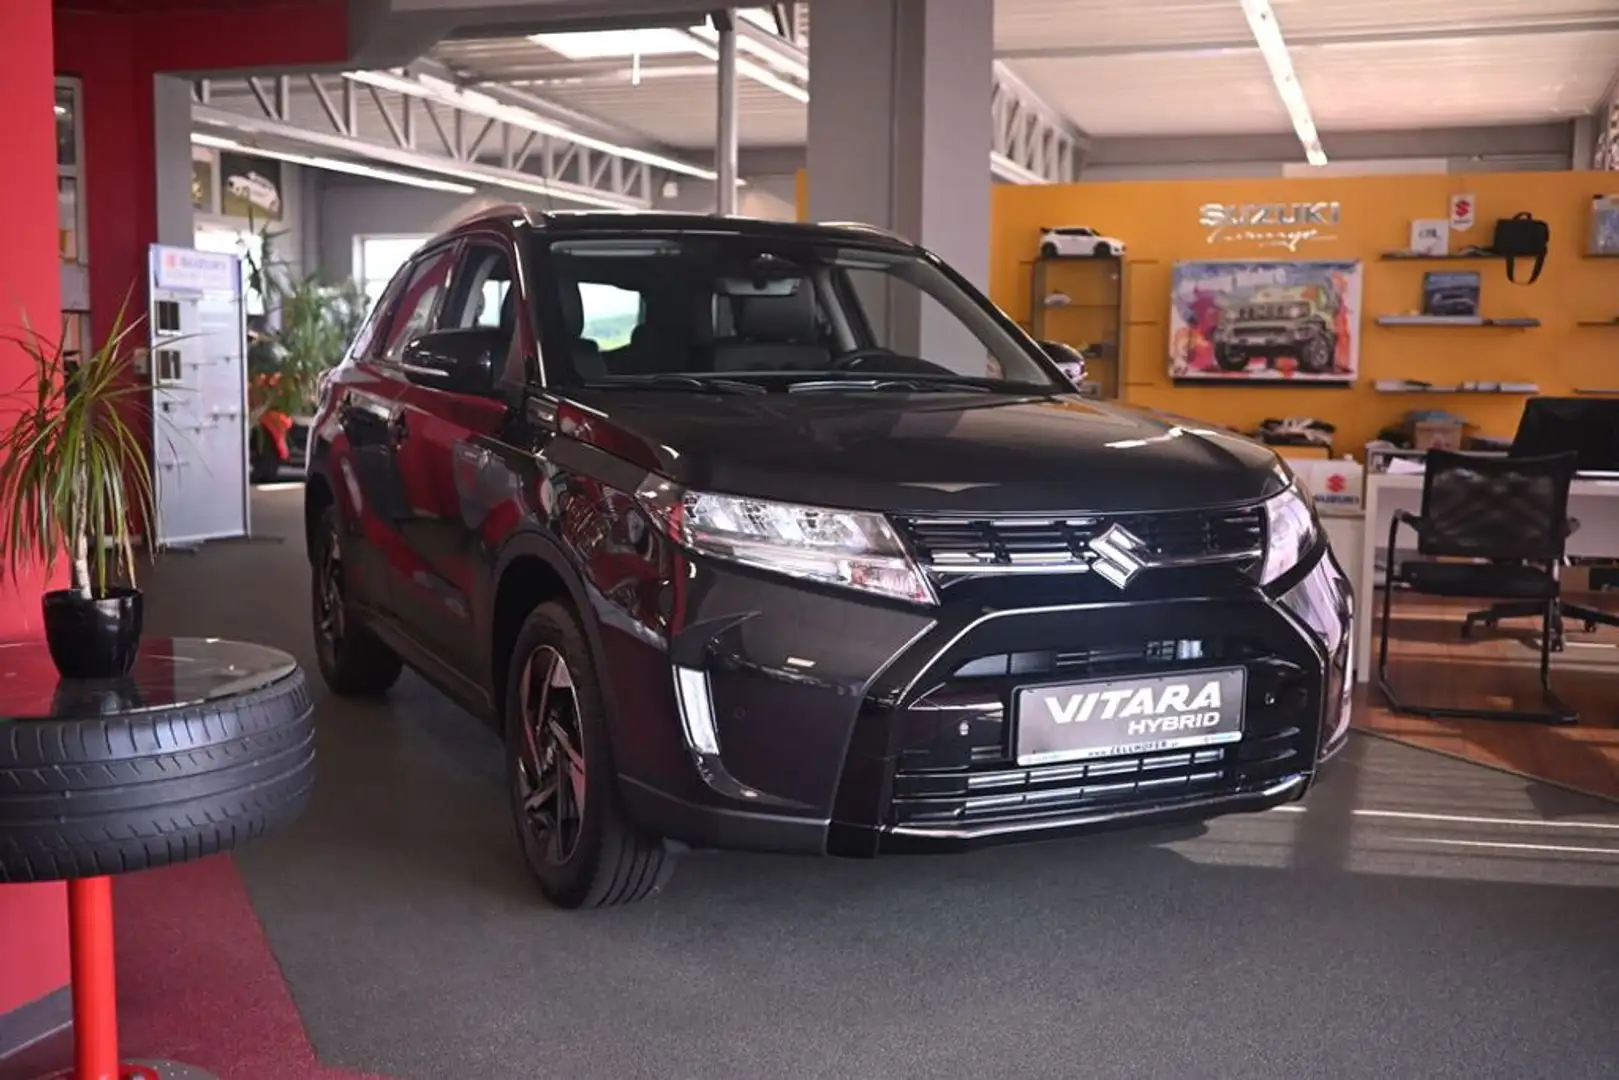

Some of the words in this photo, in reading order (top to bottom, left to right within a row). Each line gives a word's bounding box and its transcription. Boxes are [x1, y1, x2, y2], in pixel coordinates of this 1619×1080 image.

[1199, 202, 1340, 226] SUZUKI
[1045, 681, 1221, 724] VITARA
[1128, 712, 1221, 735] HYBRID
